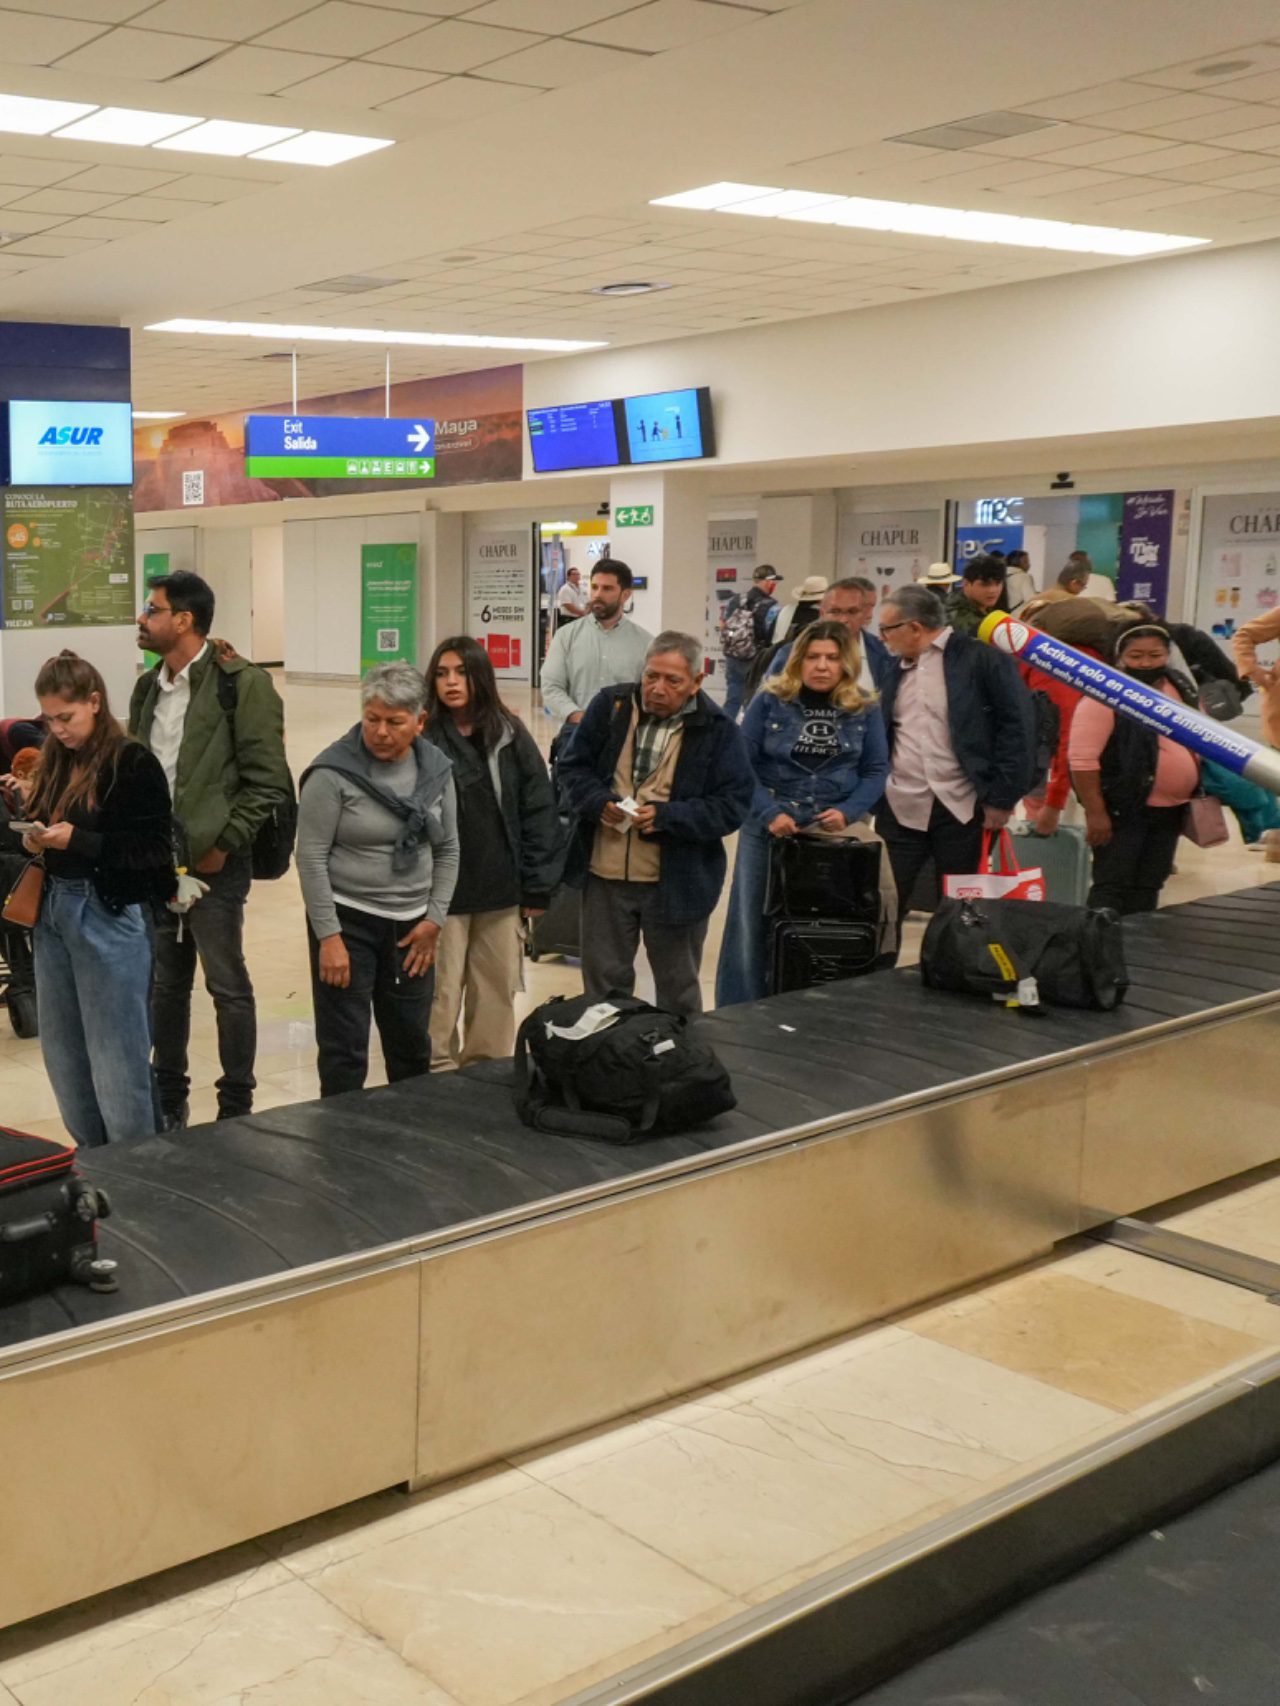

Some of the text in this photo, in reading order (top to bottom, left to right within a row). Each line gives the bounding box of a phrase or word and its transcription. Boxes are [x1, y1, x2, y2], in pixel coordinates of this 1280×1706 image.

[284, 419, 303, 434] Exit
[435, 419, 477, 435] Maya
[38, 426, 104, 445] ASUR
[284, 436, 317, 450] Salida
[861, 529, 919, 546] CHAPUR
[479, 544, 517, 558] CHAPUR
[481, 605, 492, 623] 6
[1030, 652, 1173, 735] Push only in case of emergency
[1037, 642, 1250, 758] Activar solo en caso de emergencia
